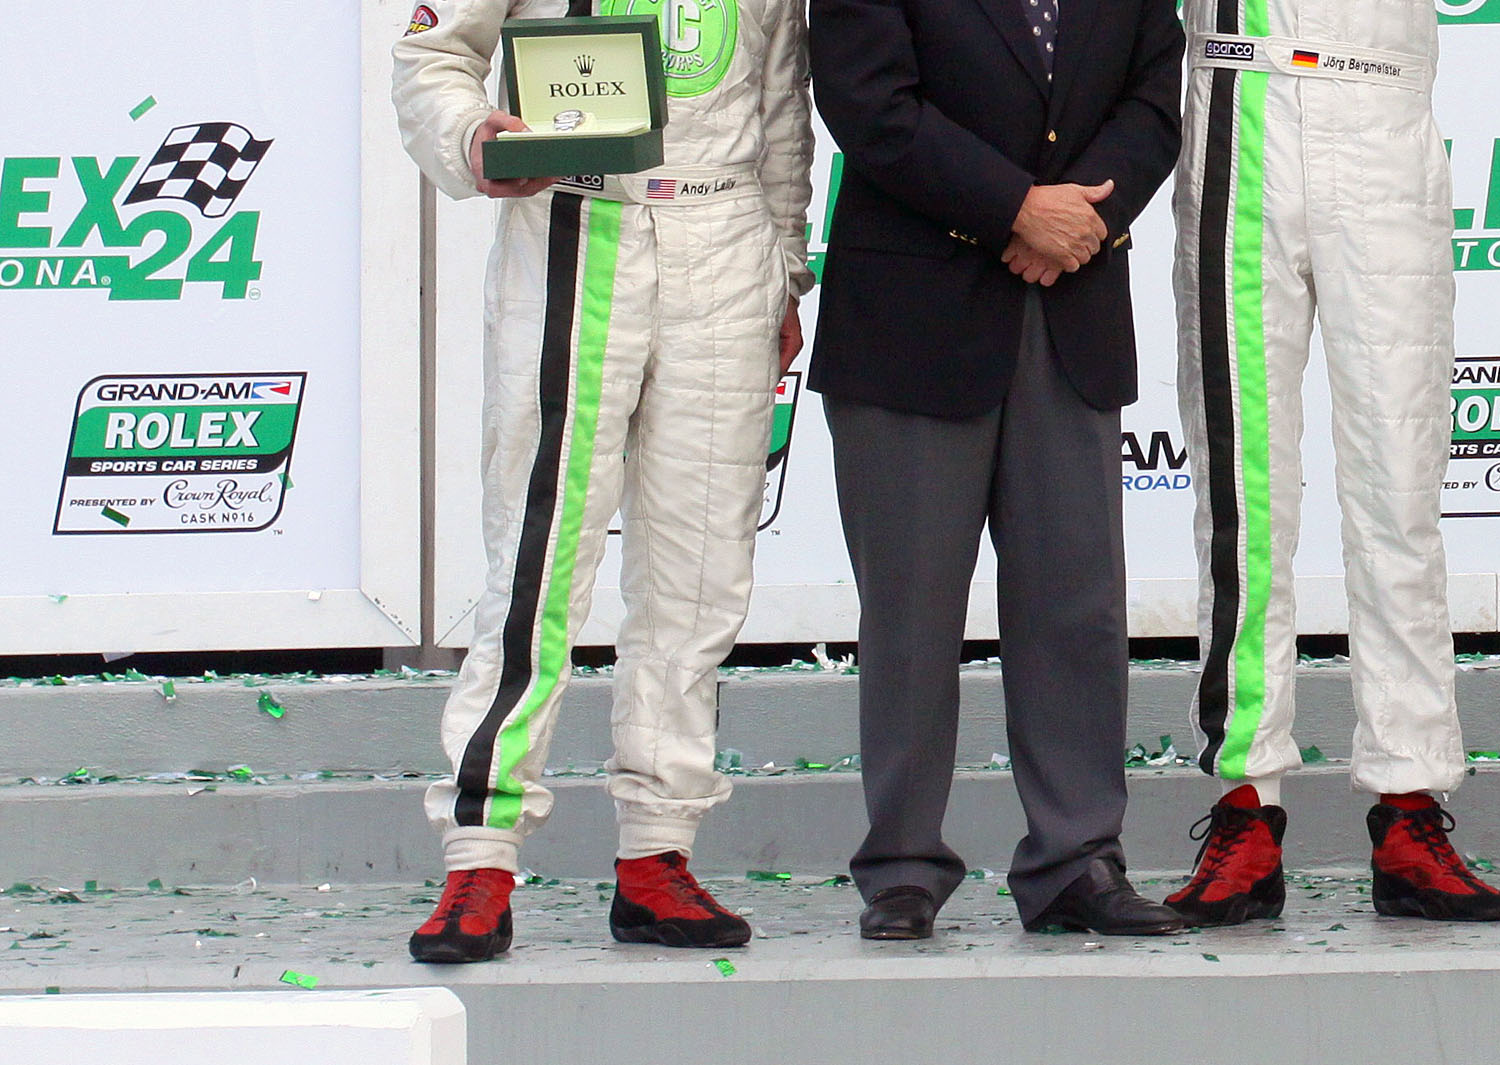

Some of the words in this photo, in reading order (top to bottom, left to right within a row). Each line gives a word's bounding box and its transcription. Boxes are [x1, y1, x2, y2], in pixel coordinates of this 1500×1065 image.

[1206, 41, 1253, 56] sparco
[1348, 58, 1401, 77] Bergmeister
[549, 81, 627, 98] ROLEX
[680, 182, 710, 195] Andy
[108, 209, 263, 301] 24
[104, 410, 263, 450] ROLEX
[90, 460, 157, 473] SPORTS
[161, 460, 199, 472] CAR
[200, 459, 258, 471] SERIES
[1462, 481, 1478, 489] BY
[163, 479, 219, 509] Crown
[199, 479, 272, 510] Royal
[69, 498, 137, 507] PRESENTED
[140, 498, 157, 507] BY
[180, 513, 216, 524] CASK
